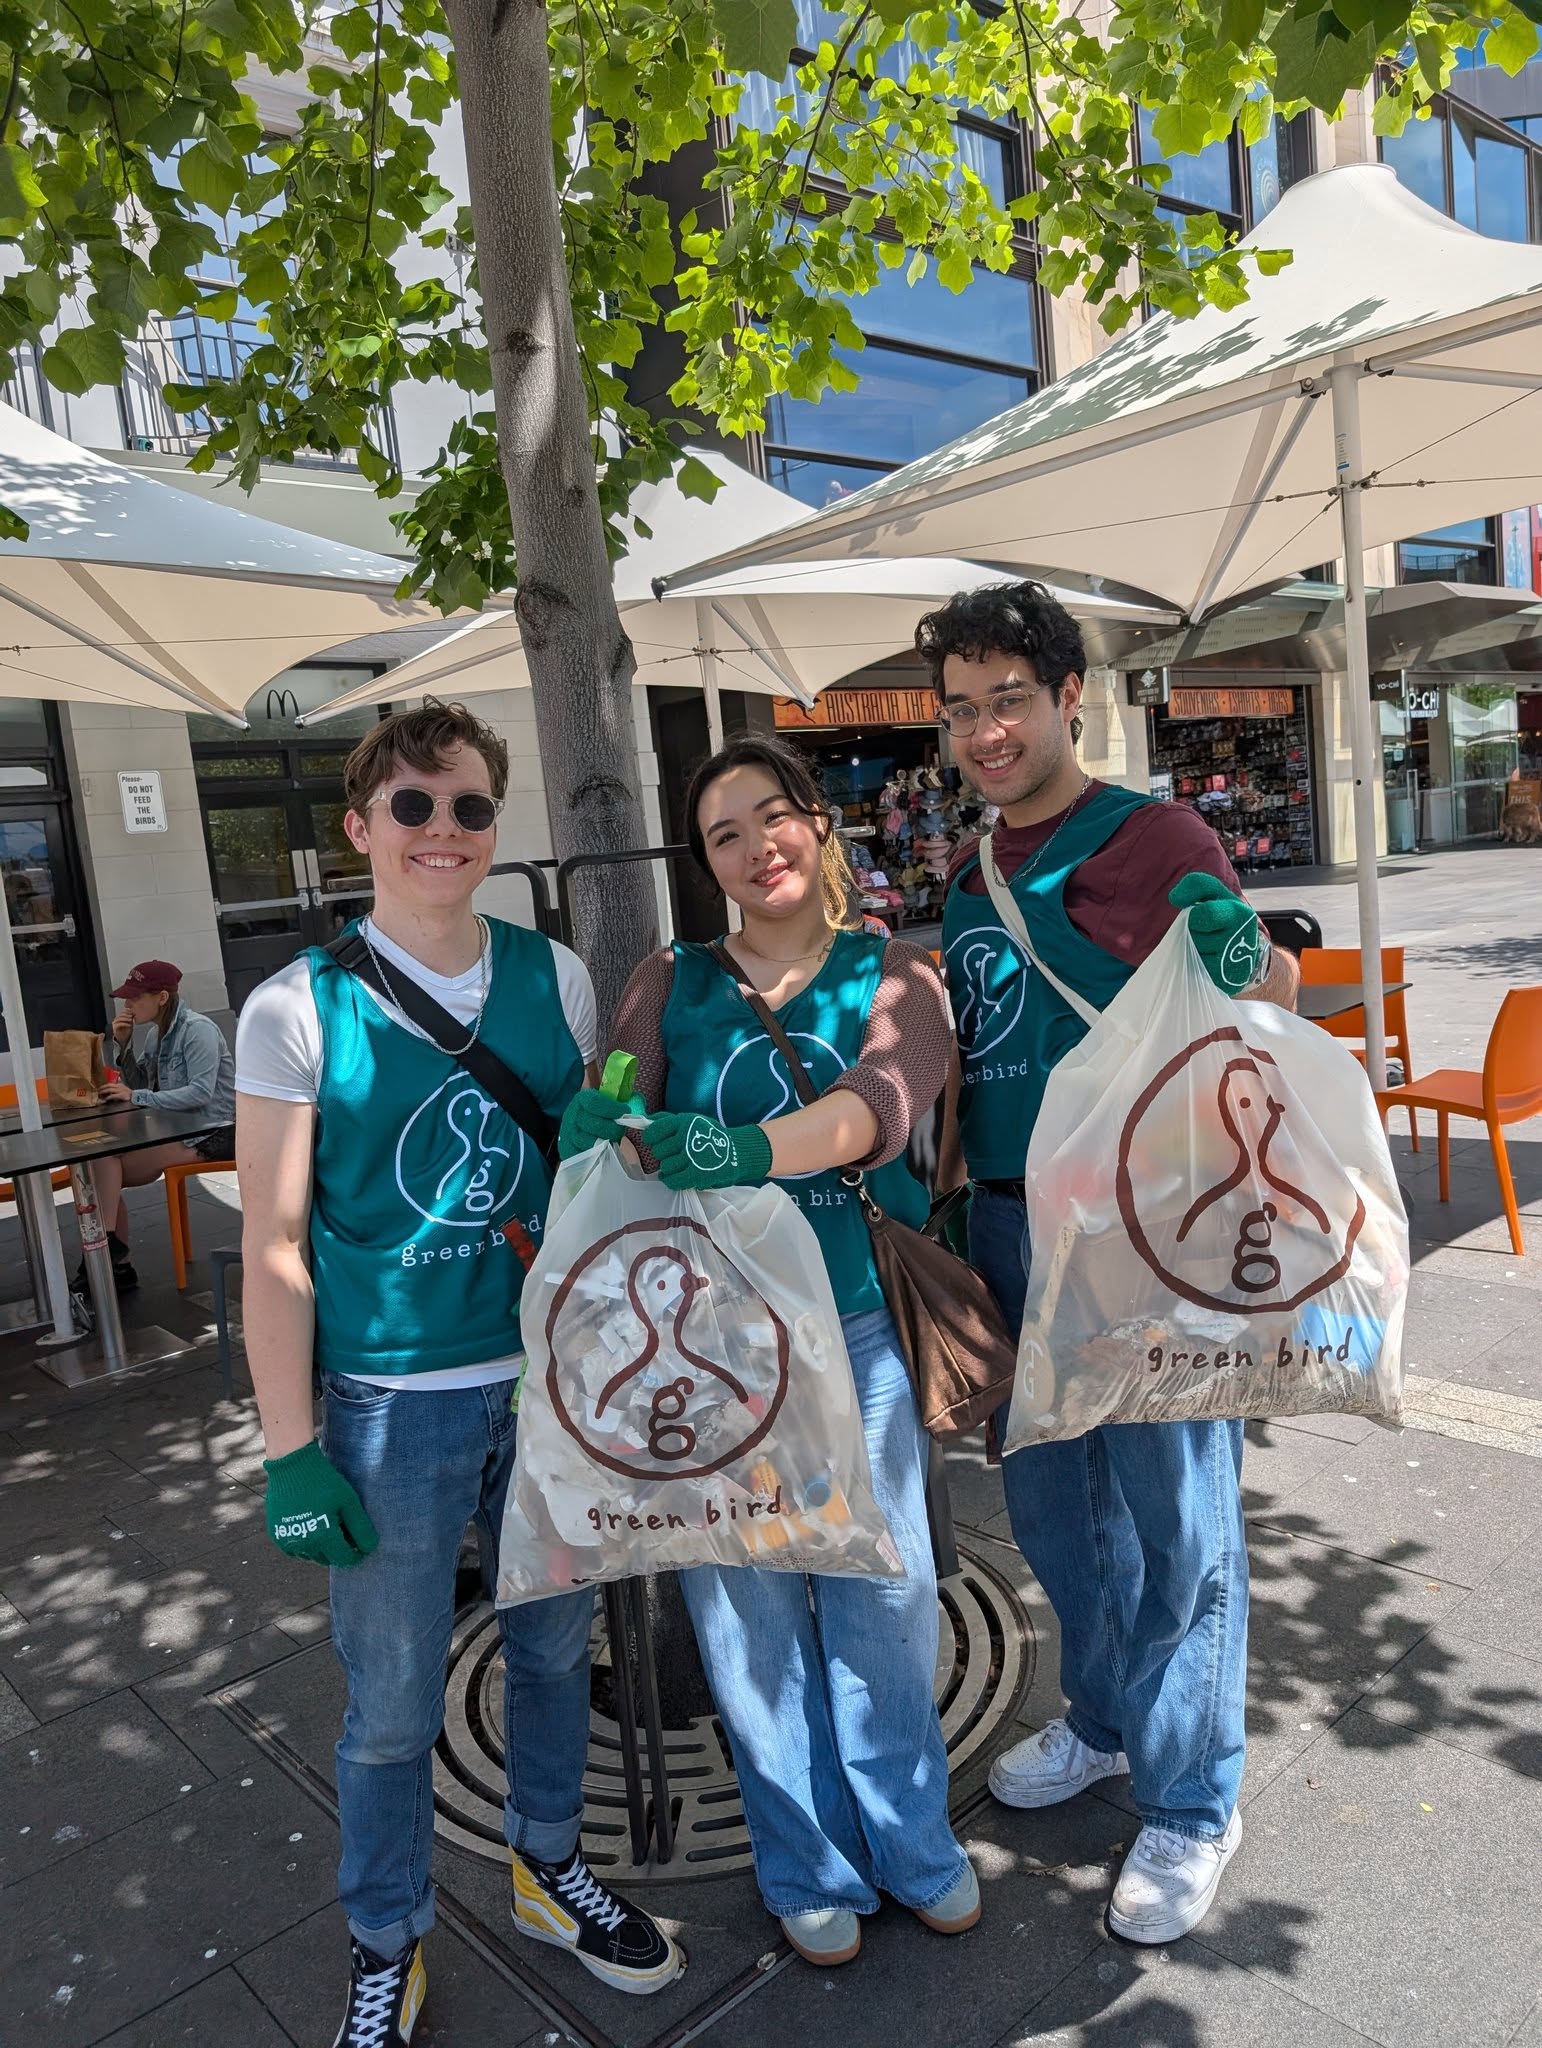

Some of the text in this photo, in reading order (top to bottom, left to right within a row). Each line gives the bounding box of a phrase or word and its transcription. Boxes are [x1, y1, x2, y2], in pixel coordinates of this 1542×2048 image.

[826, 692, 900, 723] AUSTRALIA
[902, 691, 928, 721] THE
[1174, 691, 1220, 716] SOUVENIRS
[1267, 689, 1289, 713] UGGS
[128, 785, 153, 794] DO NOT
[134, 796, 151, 805] FEED
[135, 816, 156, 825] BIRDS
[137, 806, 151, 815] THE
[982, 1058, 1028, 1081] bird
[809, 1188, 847, 1206] bir
[401, 1213, 543, 1267] green bd
[1147, 1326, 1353, 1373] green bird
[587, 1485, 782, 1530] green bird
[274, 1513, 331, 1541] Laforet
